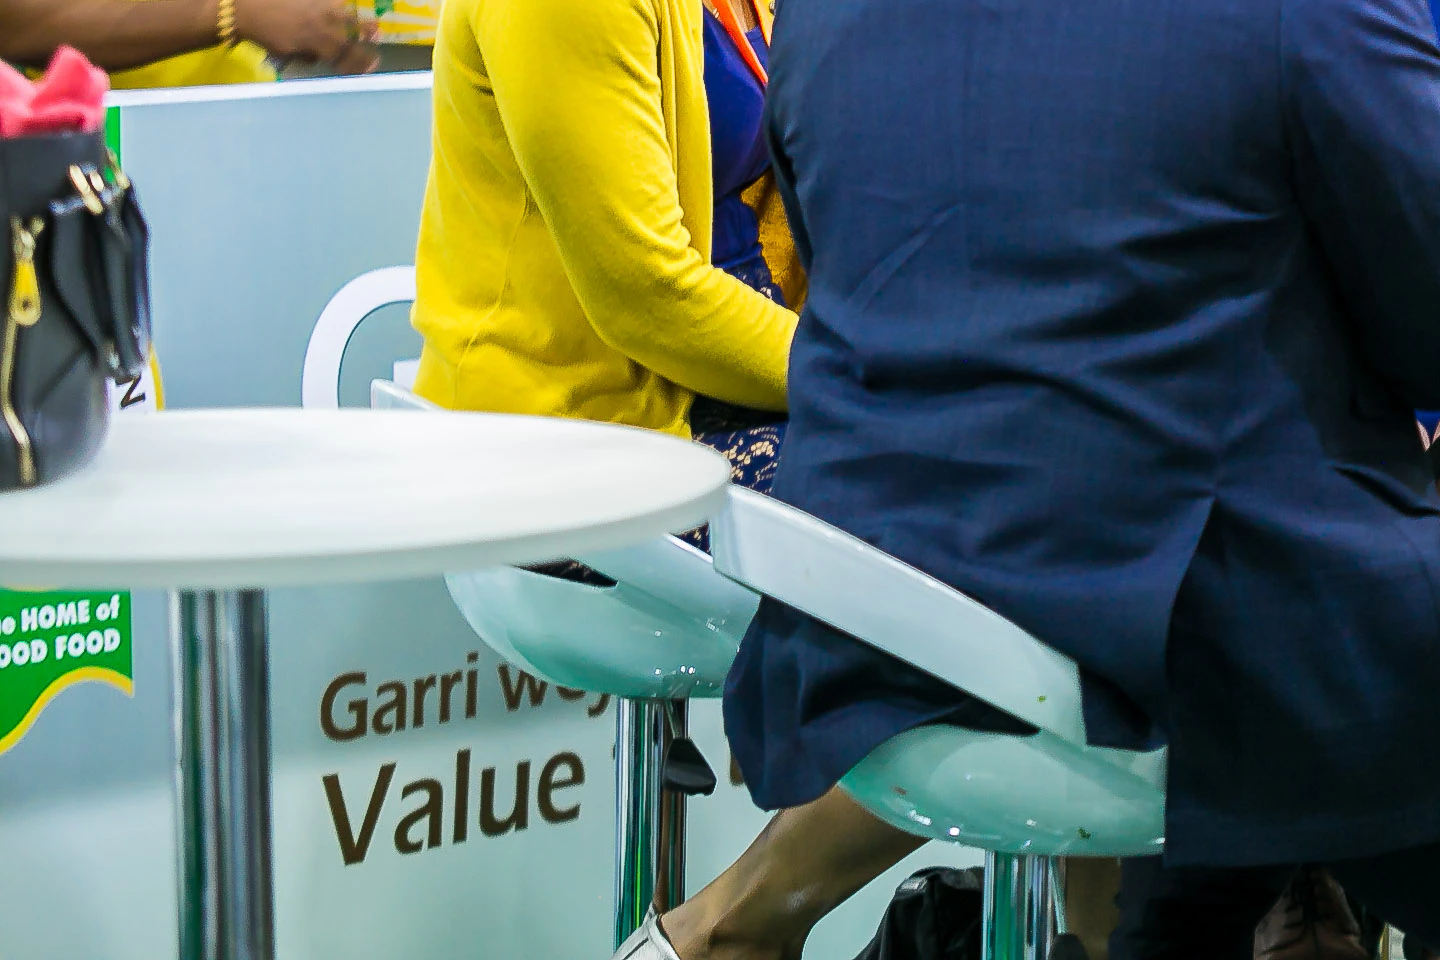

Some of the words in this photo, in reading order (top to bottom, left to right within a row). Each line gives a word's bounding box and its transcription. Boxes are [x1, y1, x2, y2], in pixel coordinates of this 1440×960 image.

[21, 599, 91, 633] HOME
[95, 593, 120, 621] of
[55, 627, 121, 661] FOOD
[319, 651, 480, 742] Garri
[322, 748, 586, 866] Value
